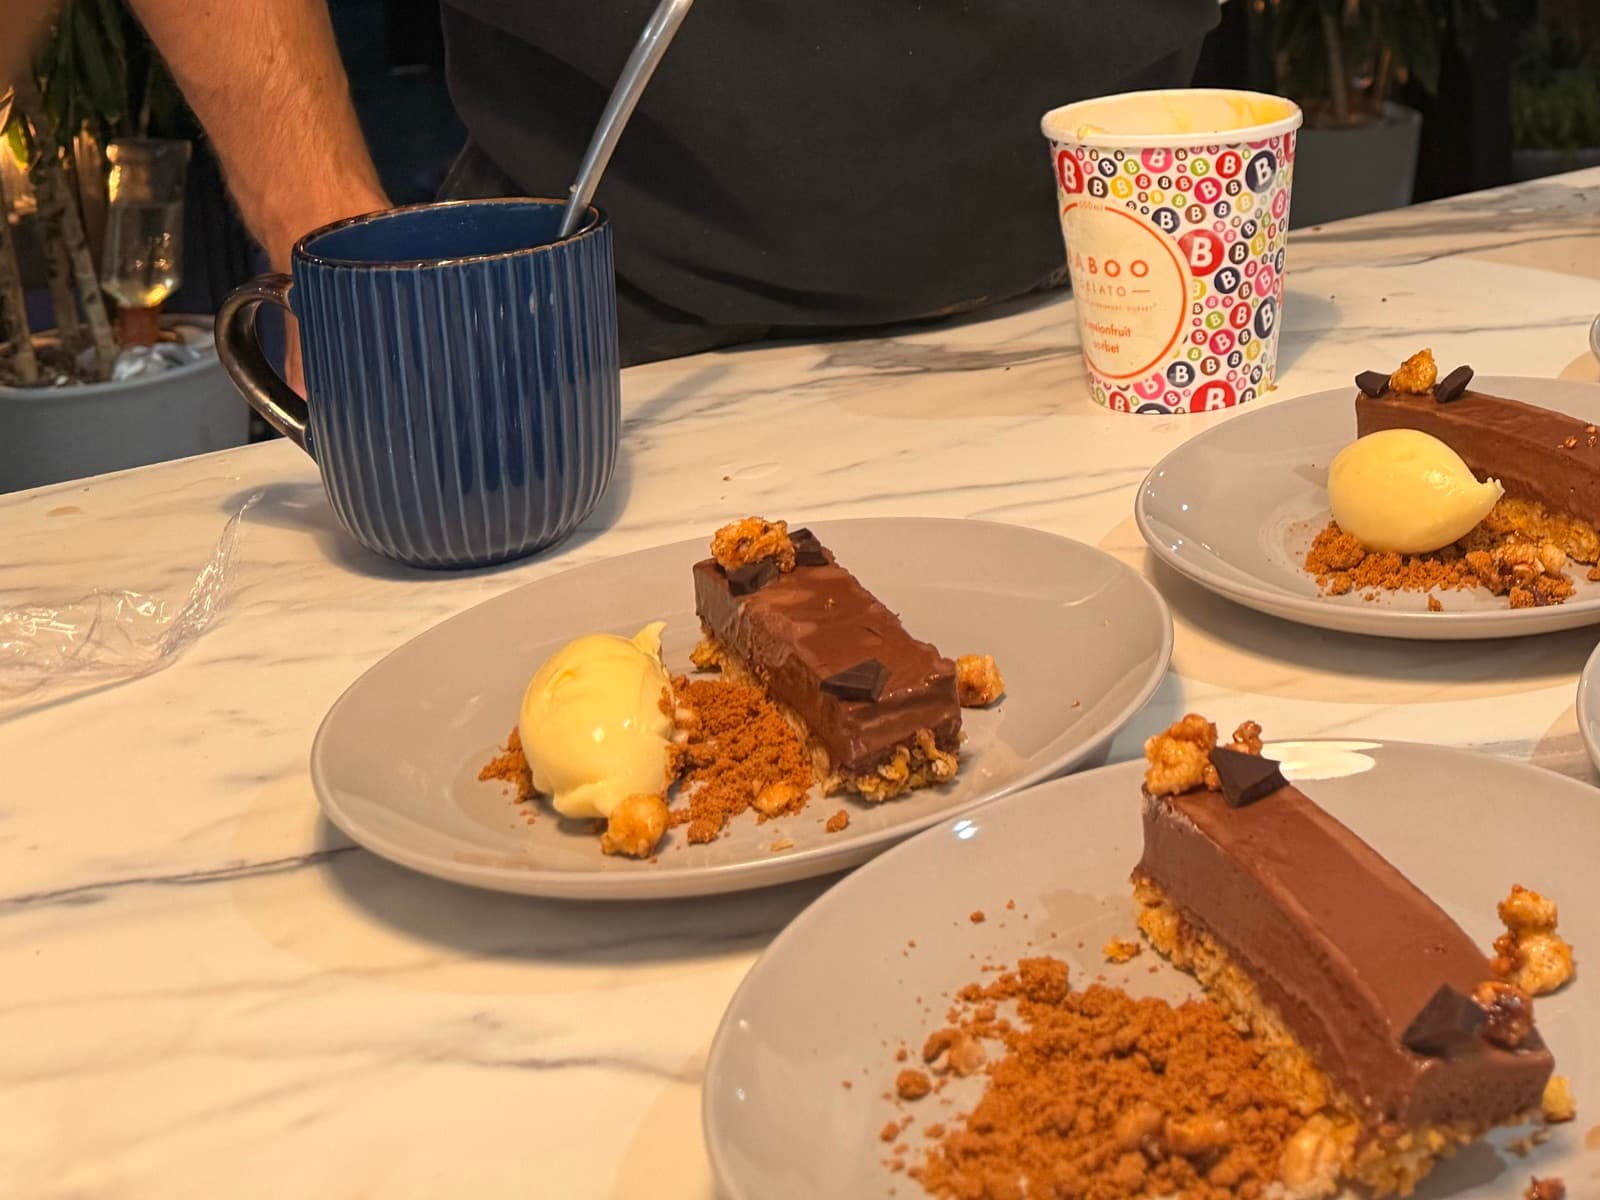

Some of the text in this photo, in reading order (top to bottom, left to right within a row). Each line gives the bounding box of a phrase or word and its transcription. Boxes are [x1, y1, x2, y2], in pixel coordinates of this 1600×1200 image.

[1063, 157, 1076, 189] B
[1102, 161, 1113, 175] B
[1195, 161, 1206, 173] B
[1223, 156, 1236, 174] B
[1255, 157, 1272, 185] B
[1093, 182, 1104, 197] B
[1201, 182, 1217, 200] B
[1230, 182, 1239, 193] B
[1160, 211, 1174, 229] B
[1191, 207, 1202, 220] B
[1244, 223, 1254, 235] B
[1191, 237, 1213, 267] B
[1235, 244, 1245, 261] B
[1068, 248, 1149, 278] ABOO
[1221, 271, 1236, 289] B
[1260, 271, 1271, 289] B
[1210, 313, 1220, 326] B
[1237, 306, 1247, 324] B
[1261, 303, 1273, 331] B
[1084, 316, 1131, 337] ionfruit
[1215, 333, 1231, 350] B
[1206, 359, 1216, 373] B
[1231, 353, 1240, 365] B
[1175, 365, 1189, 383] B
